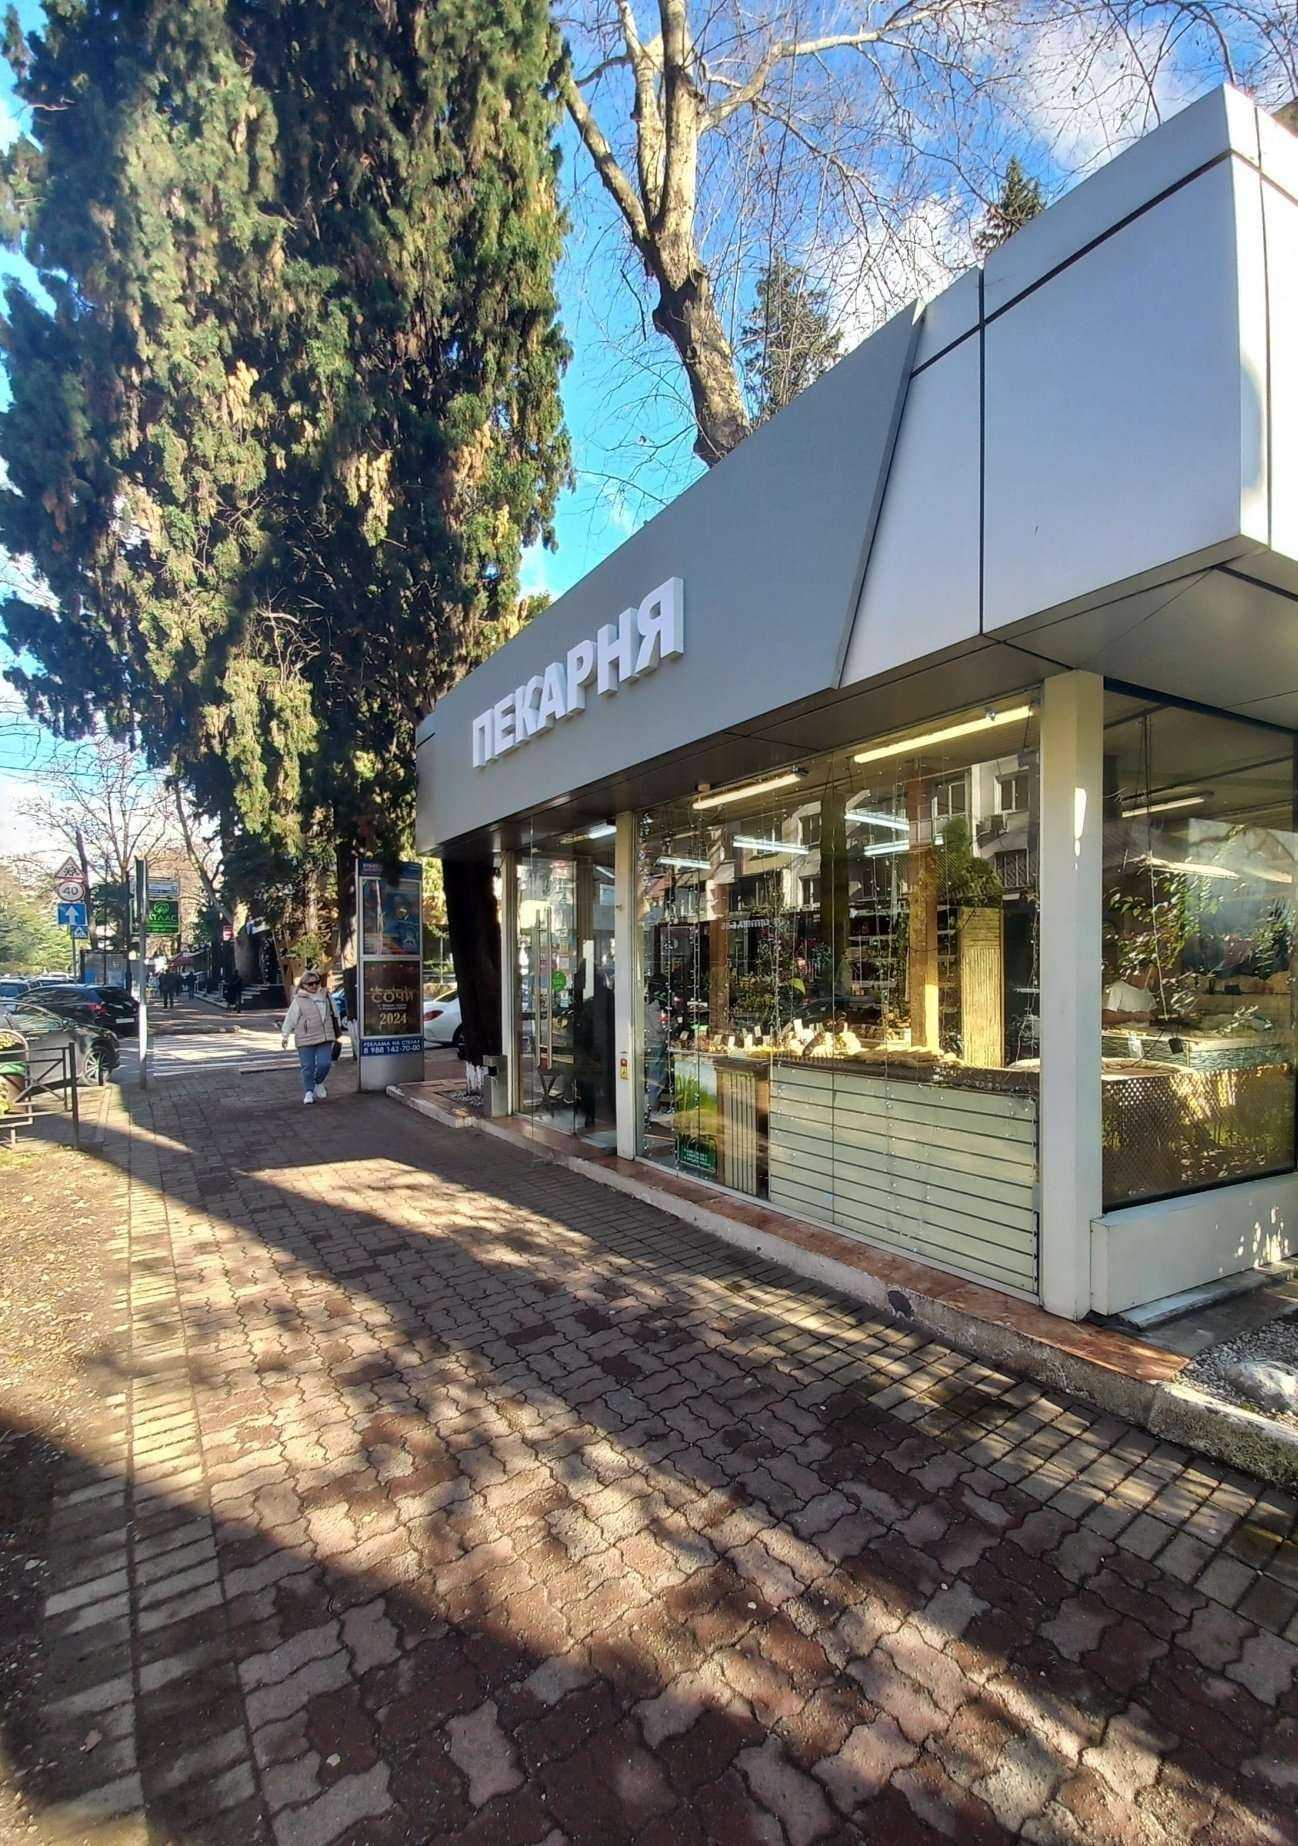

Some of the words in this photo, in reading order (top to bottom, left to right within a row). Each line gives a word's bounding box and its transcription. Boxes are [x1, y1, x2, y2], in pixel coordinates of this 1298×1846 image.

[472, 576, 684, 768] ПЕКАРНЯ
[63, 887, 79, 896] 40
[371, 991, 414, 1003] СОЧИ
[379, 1012, 407, 1024] 2024
